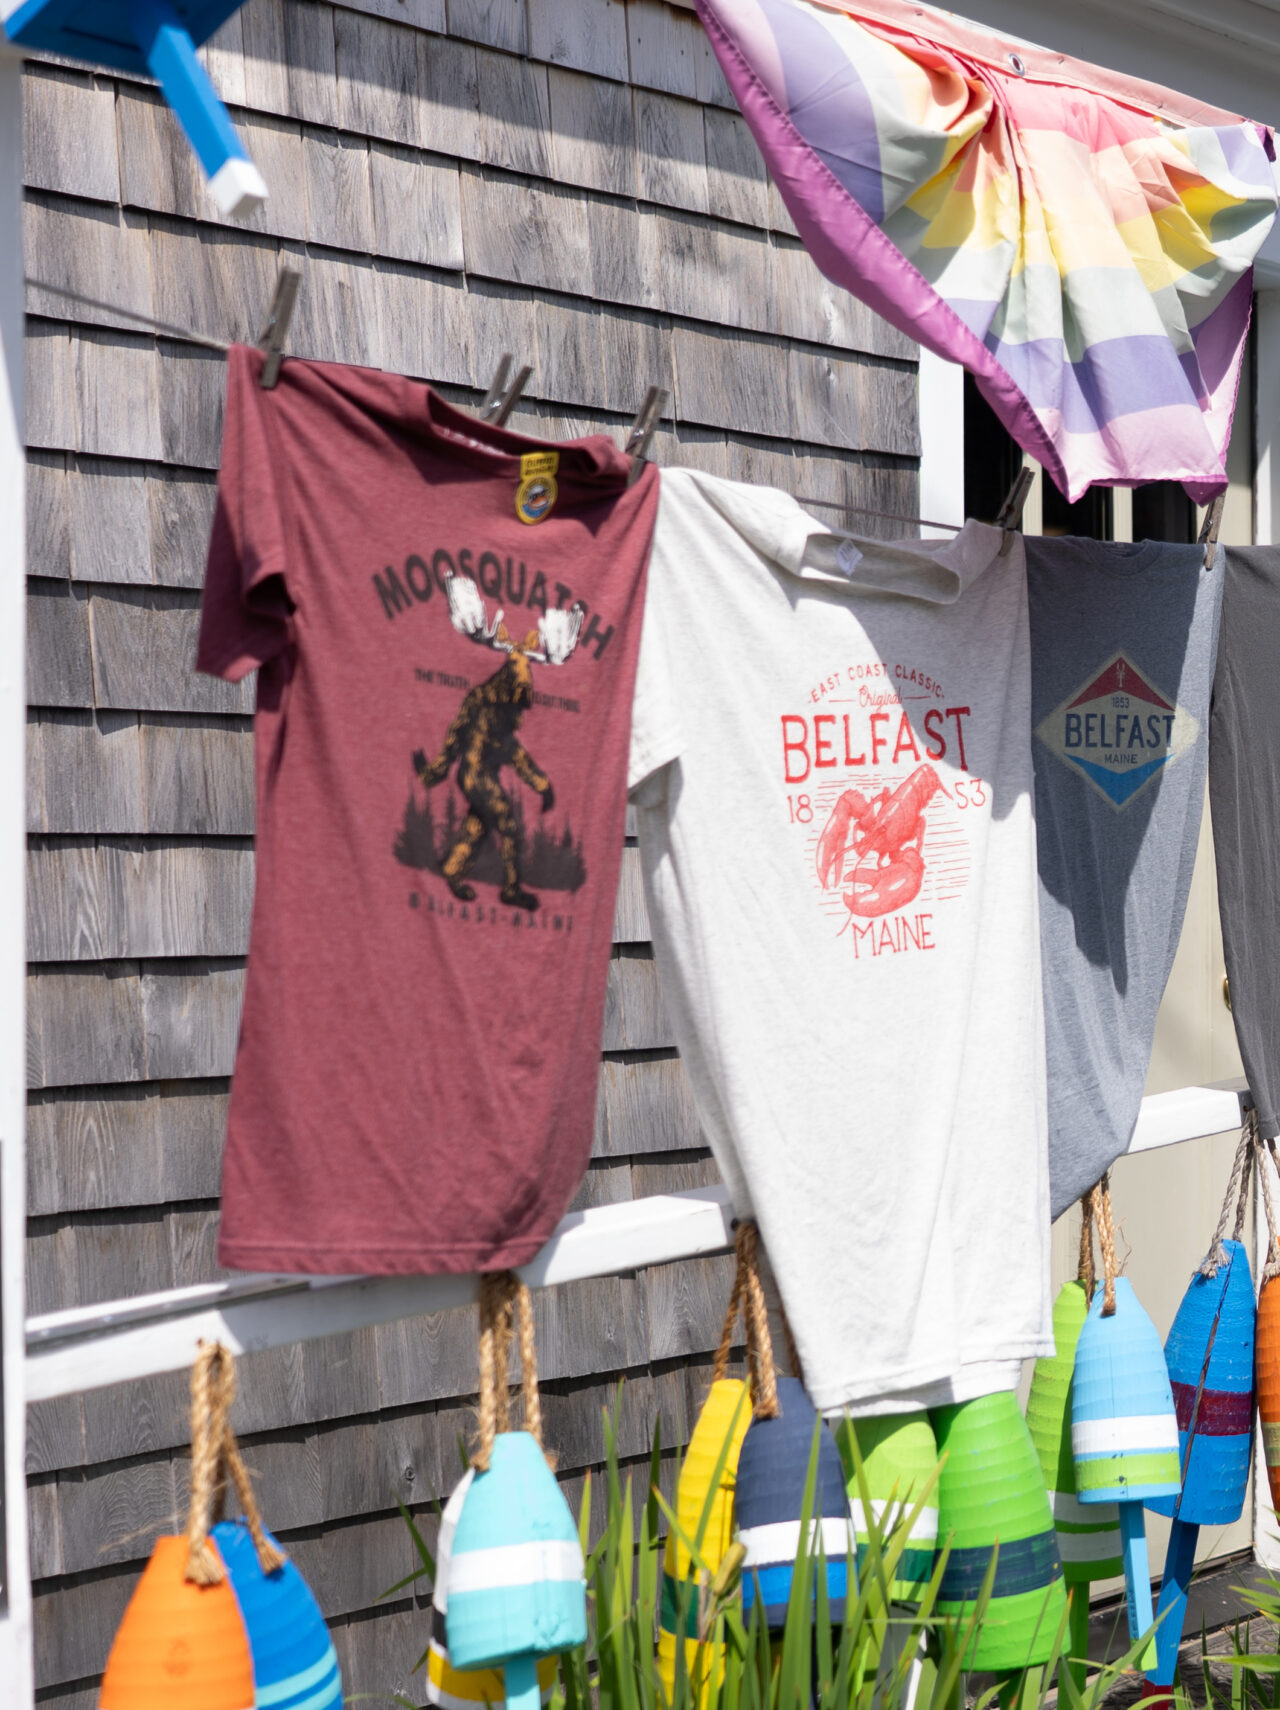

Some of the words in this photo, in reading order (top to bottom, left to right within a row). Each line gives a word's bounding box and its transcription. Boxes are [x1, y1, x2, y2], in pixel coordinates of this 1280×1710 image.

[847, 663, 888, 681] COAST
[859, 685, 903, 713] Original
[1111, 697, 1130, 709] 1853
[781, 706, 971, 783] BELFAST
[1064, 713, 1177, 749] BELFAST
[1104, 753, 1138, 764] MAINE
[787, 794, 814, 824] 18
[954, 778, 987, 809] 53
[852, 914, 936, 958] MAINE
